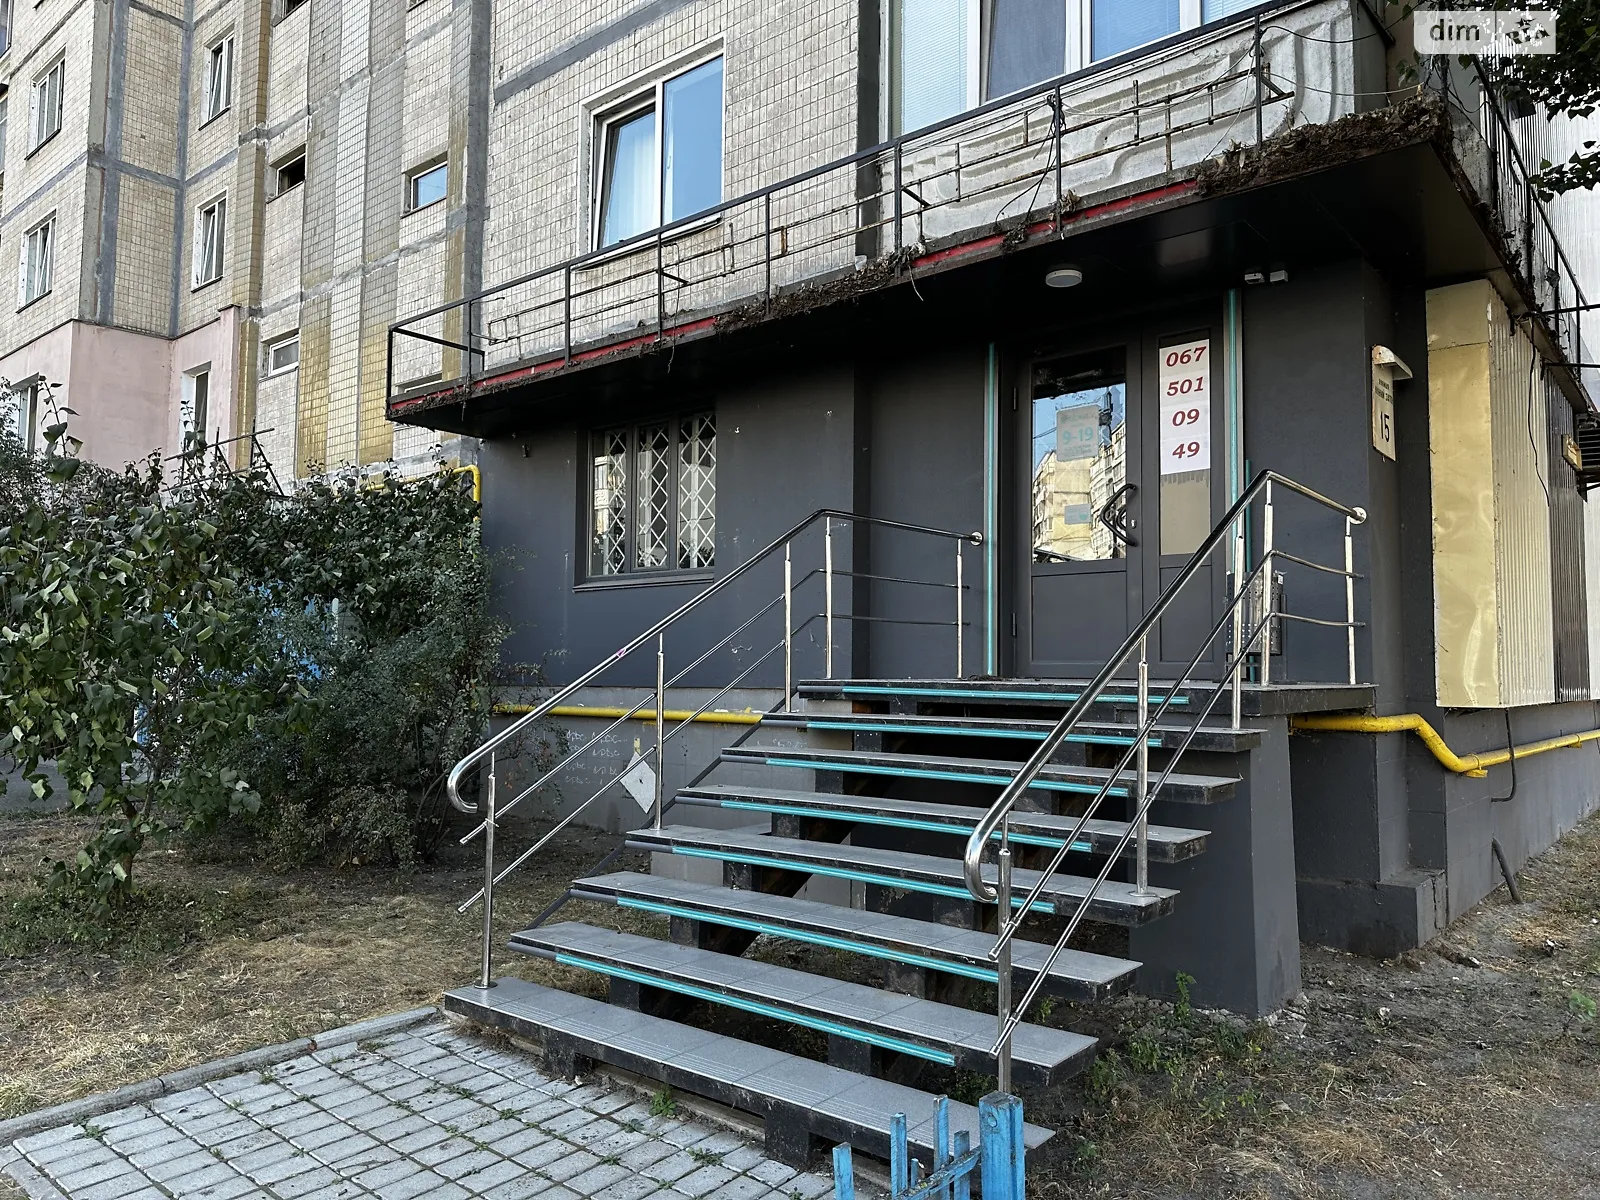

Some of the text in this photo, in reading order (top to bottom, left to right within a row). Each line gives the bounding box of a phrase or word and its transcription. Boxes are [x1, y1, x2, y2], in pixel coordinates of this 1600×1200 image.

[1166, 346, 1207, 367] 067
[1166, 376, 1204, 397] 501
[1172, 408, 1200, 427] 09
[1380, 411, 1390, 443] 15
[1062, 426, 1093, 444] 9-19
[1172, 441, 1200, 459] 49
